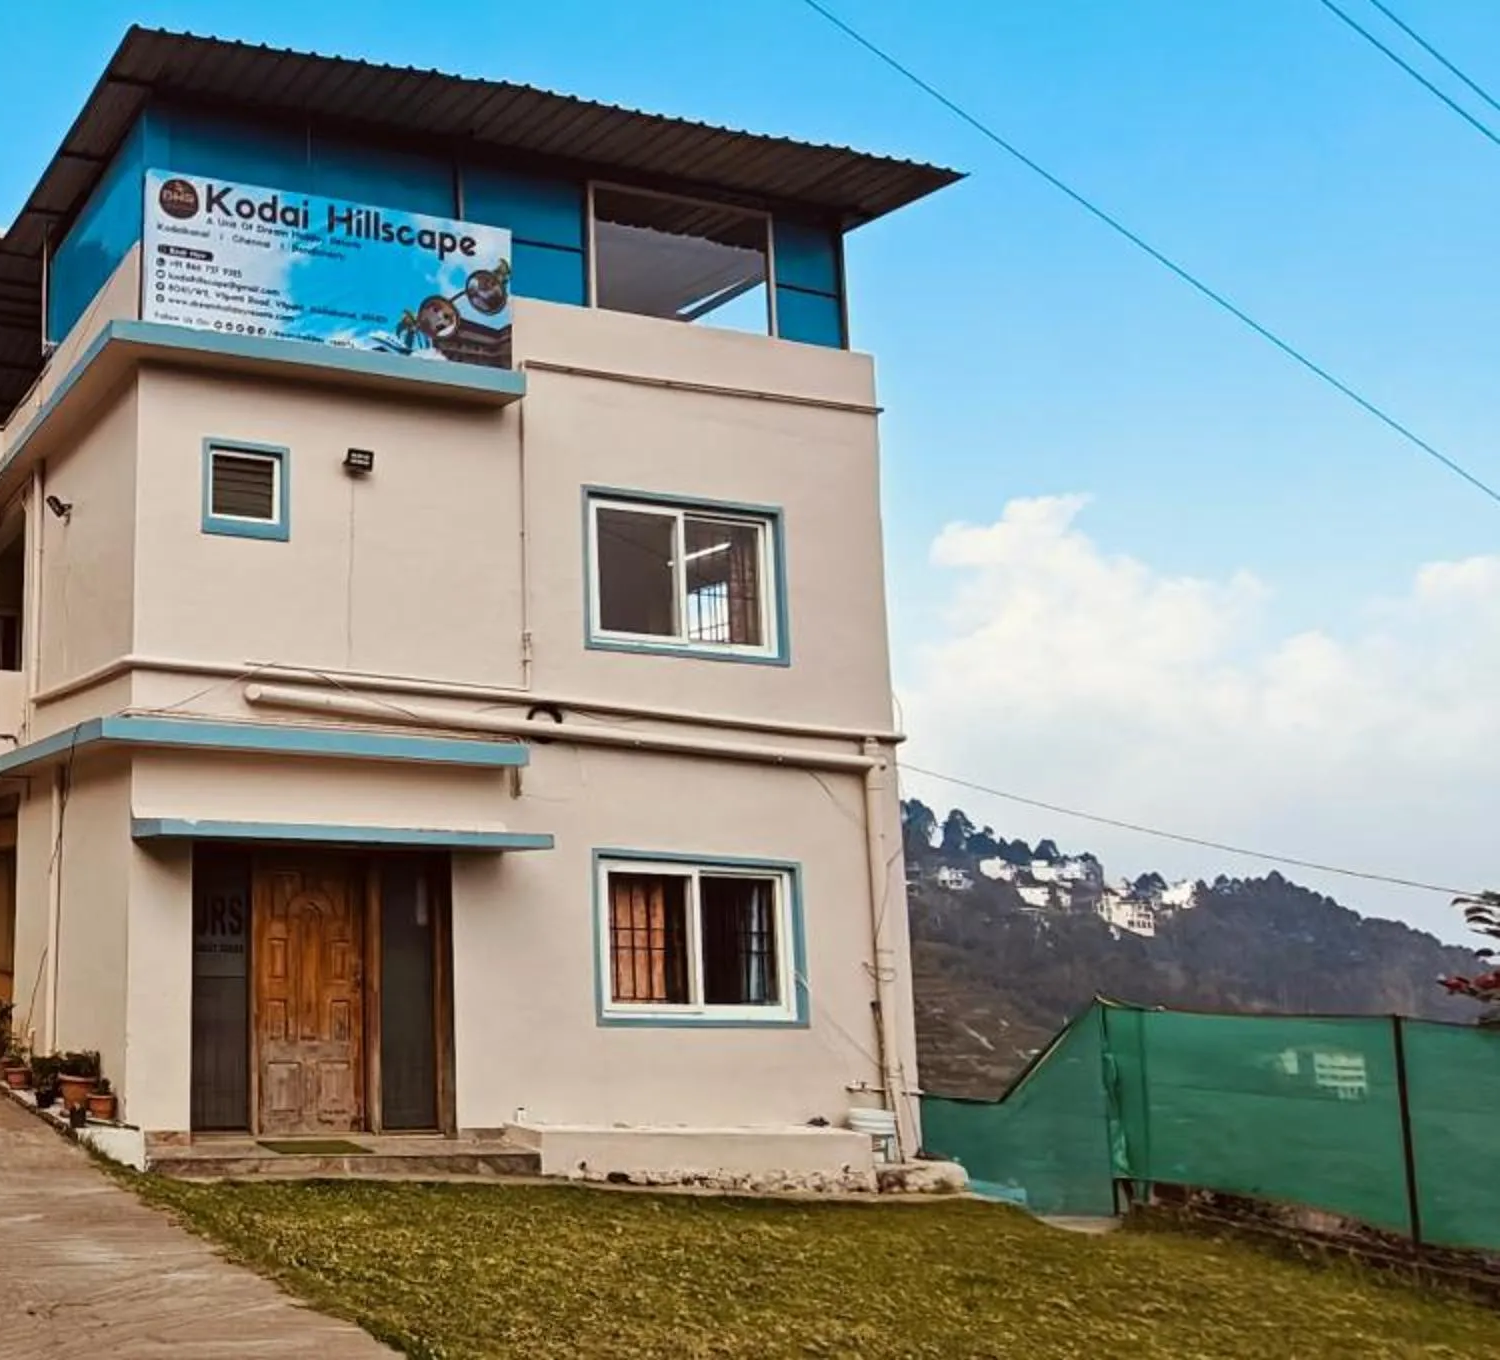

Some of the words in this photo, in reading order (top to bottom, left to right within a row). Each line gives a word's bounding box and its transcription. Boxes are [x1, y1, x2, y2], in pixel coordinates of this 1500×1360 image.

[206, 184, 308, 229] Kodai
[328, 205, 477, 260] Hillscape
[218, 219, 238, 228] Unit
[256, 225, 288, 236] Dream
